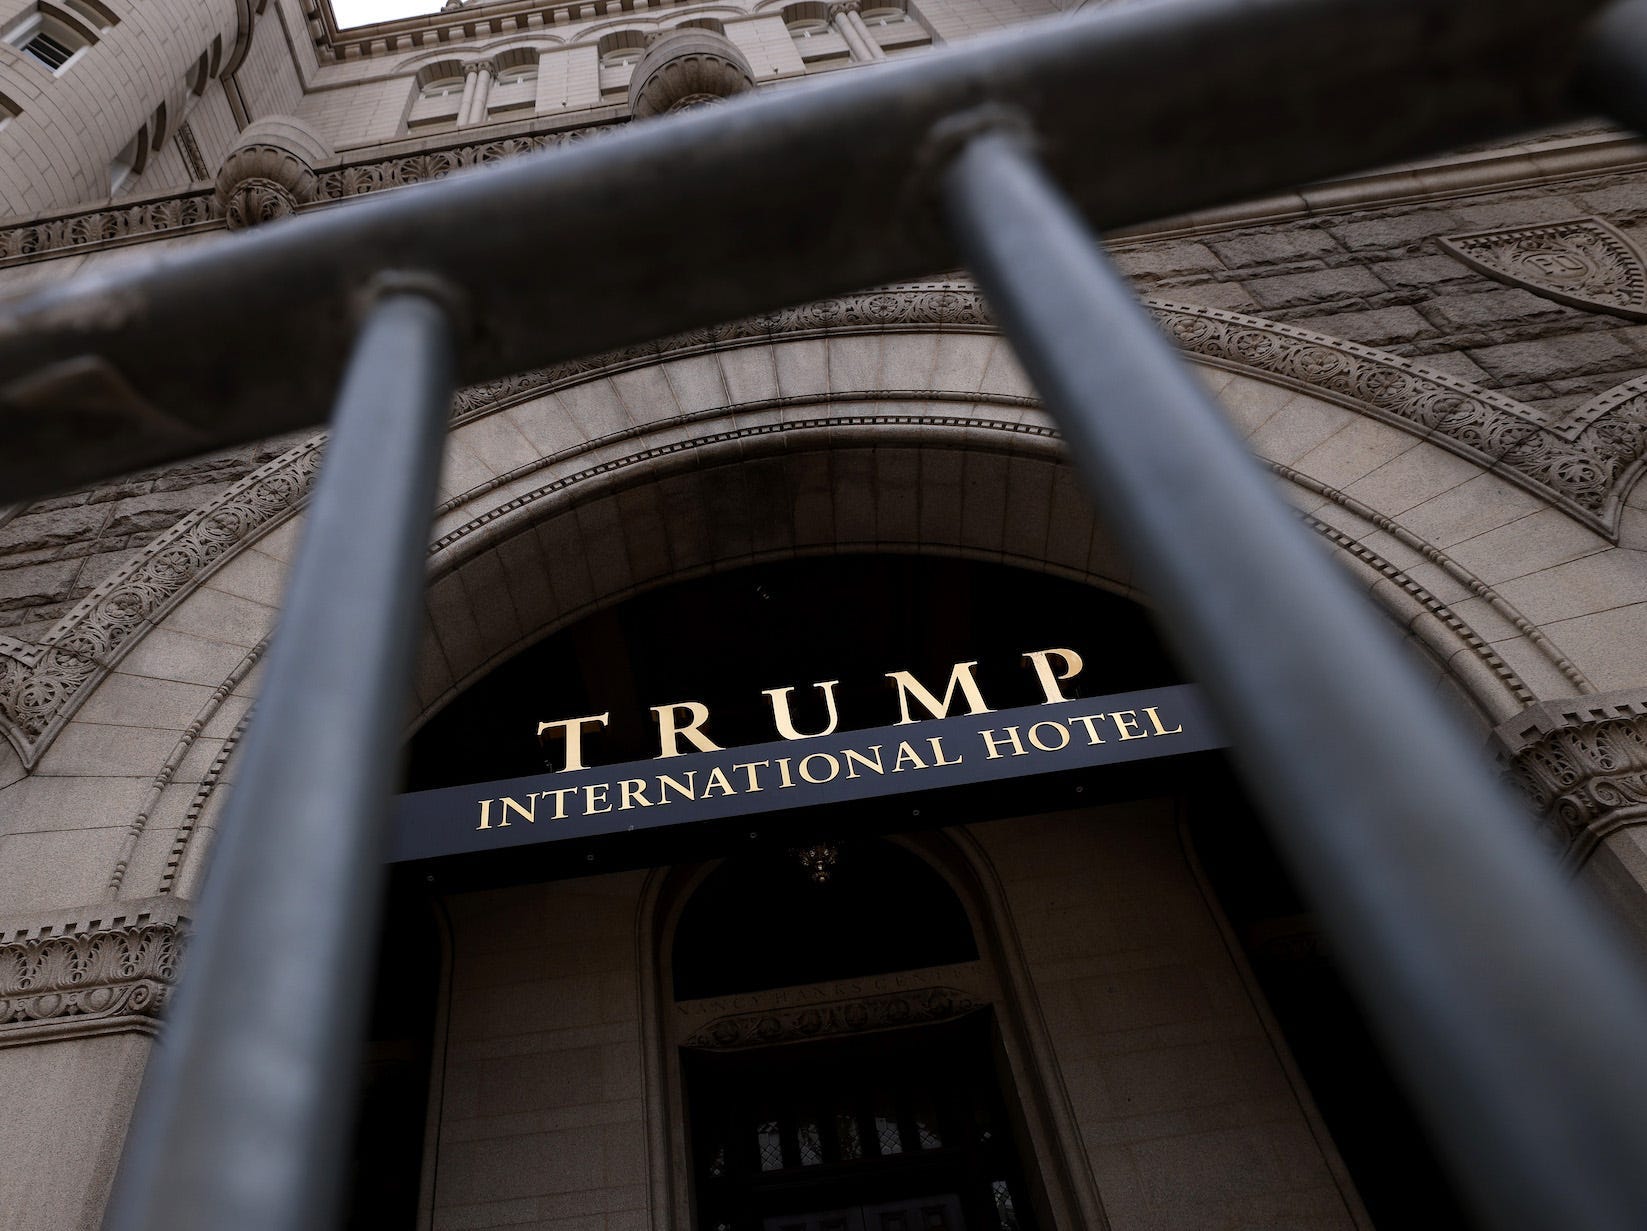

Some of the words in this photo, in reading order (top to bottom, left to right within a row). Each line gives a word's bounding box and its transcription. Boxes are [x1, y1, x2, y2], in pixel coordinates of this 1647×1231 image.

[476, 736, 963, 830] INTERNATIONAL
[978, 706, 1184, 760] HOTEL
[537, 648, 1083, 773] TRUMP
